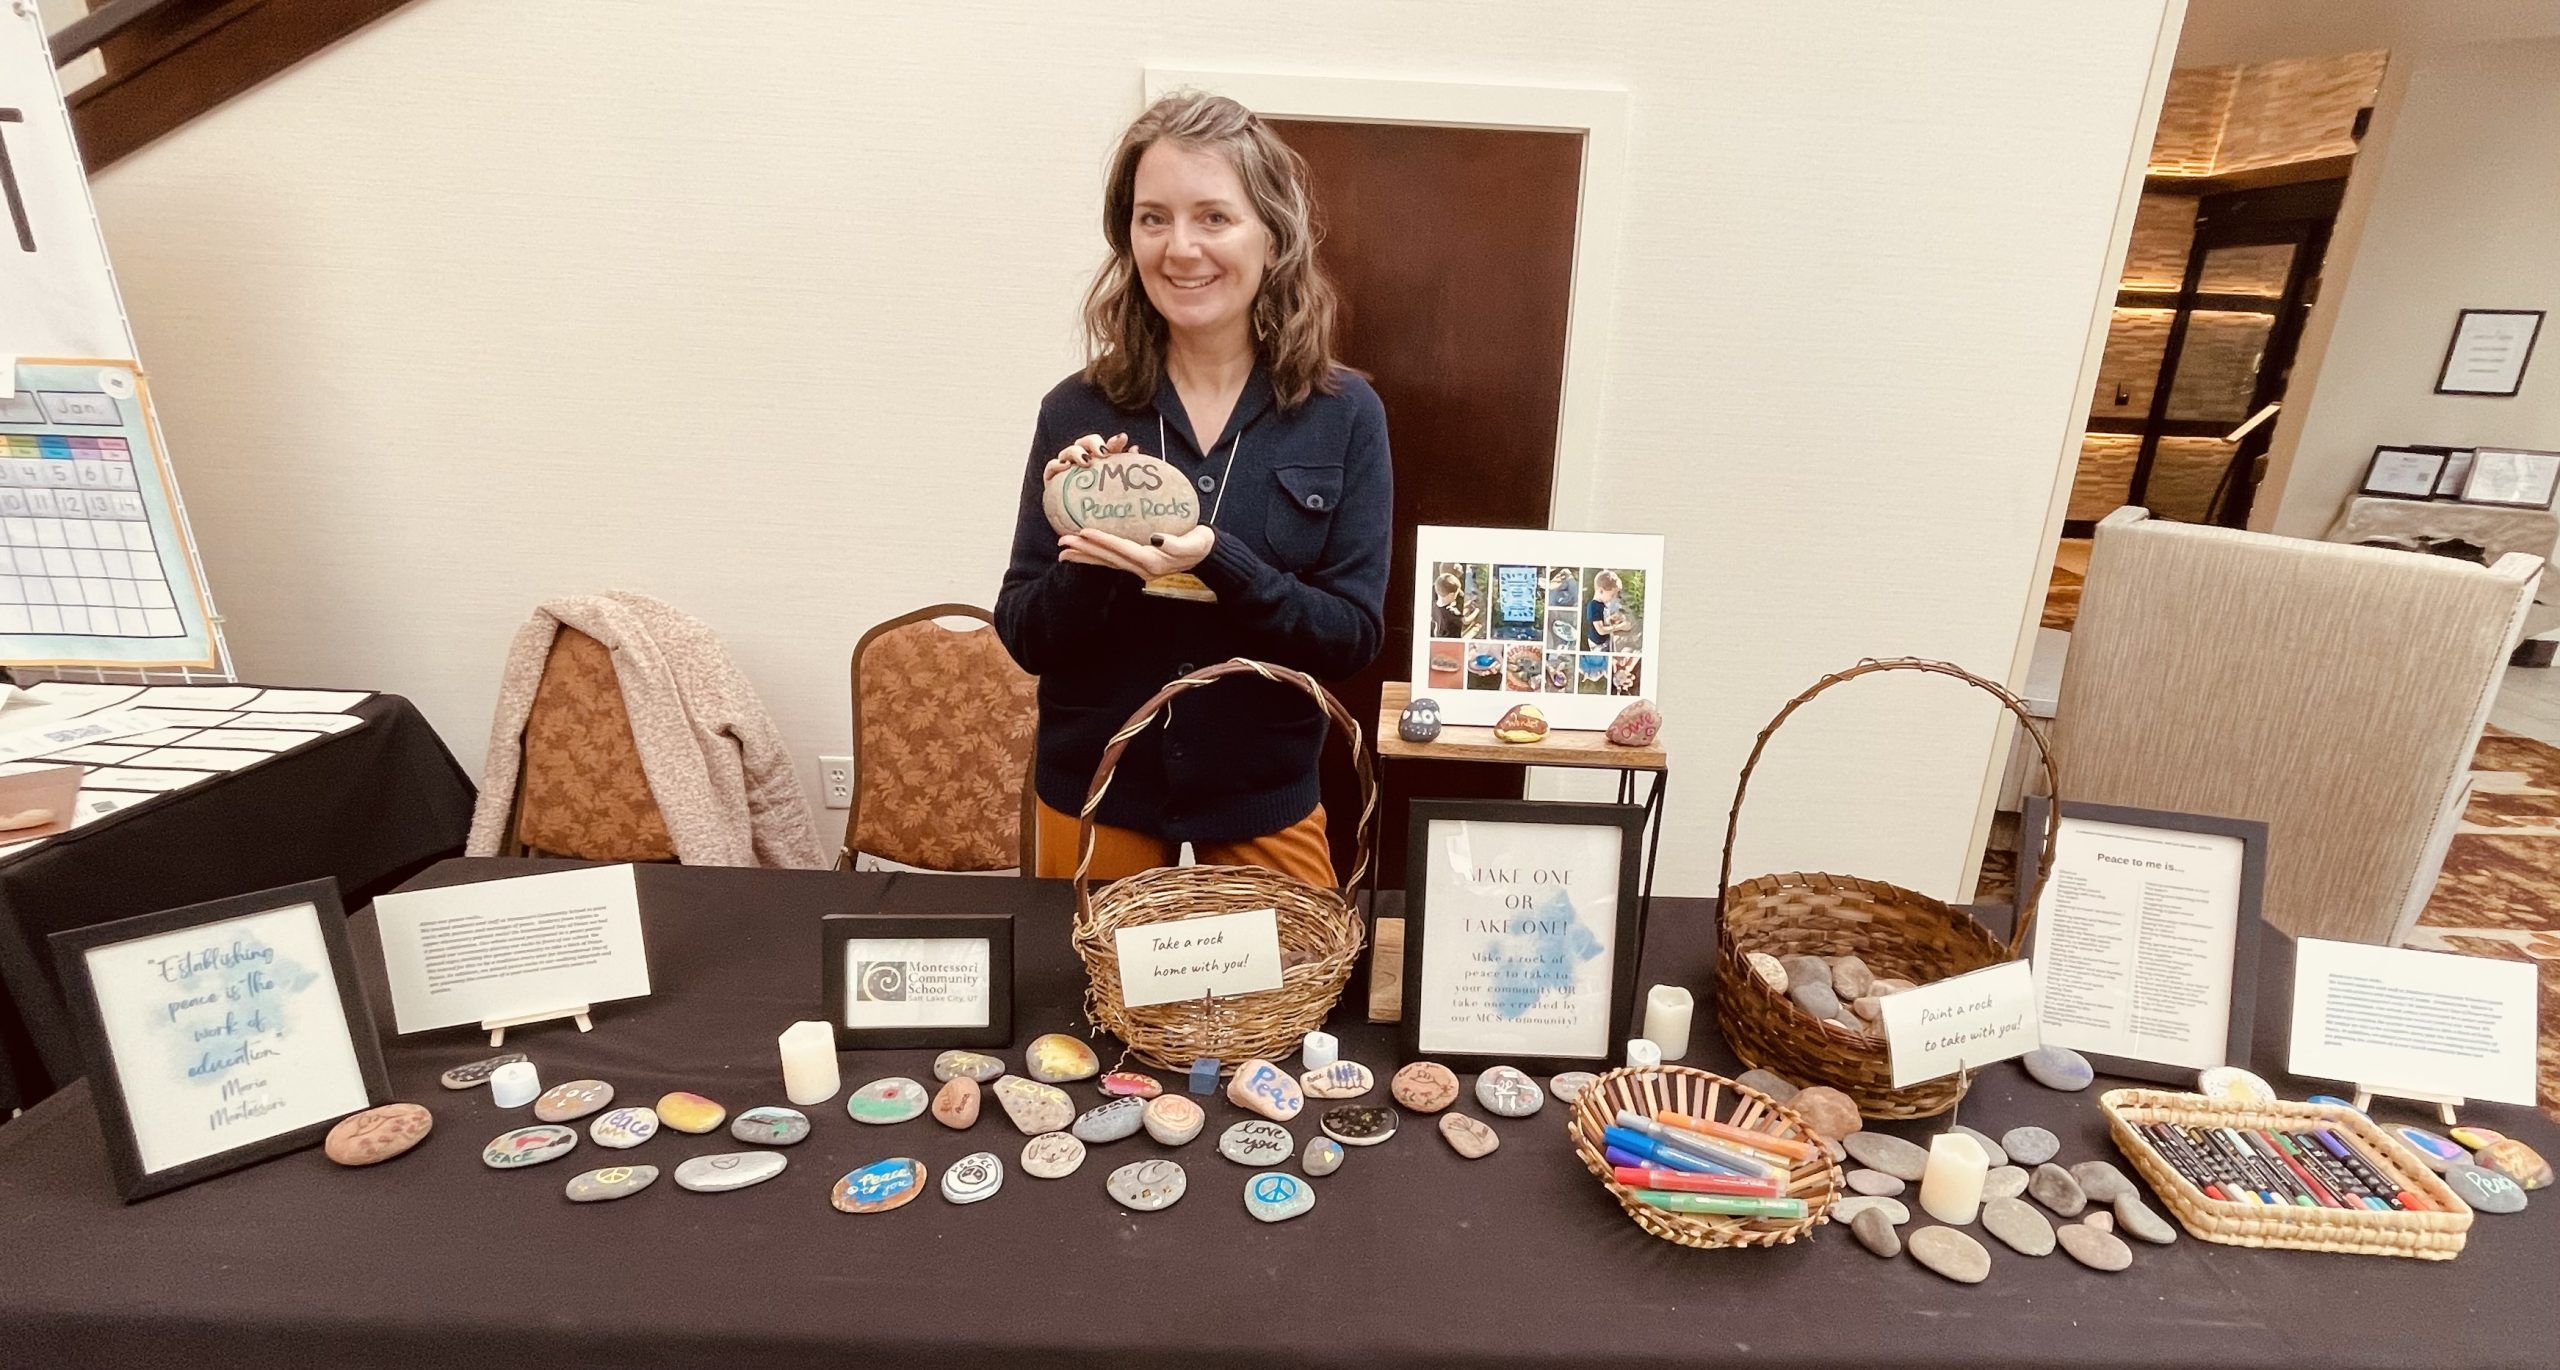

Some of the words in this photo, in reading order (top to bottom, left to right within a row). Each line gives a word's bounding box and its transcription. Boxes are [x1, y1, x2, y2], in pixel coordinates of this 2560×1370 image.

[22, 466, 37, 480] 4
[52, 466, 66, 481] 5
[85, 466, 96, 481] 6
[113, 467, 124, 481] 7
[1099, 463, 1163, 491] MCS
[34, 495, 48, 510] 11
[62, 497, 82, 512] 12
[90, 496, 108, 511] 13
[1081, 497, 1135, 520] Peace
[1139, 497, 1191, 520] Rocks
[2097, 853, 2129, 866] Peace
[2132, 857, 2143, 867] to
[2145, 860, 2162, 870] me
[1533, 869, 1574, 885] ONE
[1505, 895, 1533, 910] OR
[1464, 918, 1511, 934] TAKE
[1522, 919, 1568, 936] ONE!
[1152, 937, 1180, 951] Take
[1184, 939, 1191, 947] a
[1197, 931, 1224, 946] rock
[1154, 965, 1187, 977] home
[1192, 959, 1219, 973] with
[1222, 953, 1250, 973] you!
[1472, 952, 1501, 963] Make
[1518, 954, 1546, 964] rock
[1552, 955, 1564, 964] of
[909, 962, 978, 973] Montessori
[1464, 970, 1500, 980] peace
[1506, 970, 1518, 979] to
[1524, 970, 1551, 980] take
[1555, 971, 1568, 980] to
[908, 973, 978, 987] Community
[908, 984, 947, 994] School
[1455, 984, 1482, 994] your
[1487, 985, 1551, 996] community
[1453, 998, 1478, 1008] take
[1510, 1000, 1558, 1010] created
[1921, 1006, 1953, 1025] Paint
[1956, 1006, 1965, 1015] a
[1969, 994, 1993, 1011] rock
[194, 1012, 237, 1042] work
[247, 1009, 267, 1032] of
[1477, 1013, 1503, 1022] MCS
[1925, 1040, 1936, 1052] to
[1941, 1032, 1966, 1048] take
[1970, 1024, 1995, 1040] with
[1998, 1014, 2022, 1038] you!
[222, 1078, 268, 1101] Maria
[1251, 1065, 1299, 1111] Peace
[209, 1097, 286, 1130] Montessori
[1236, 1136, 1281, 1155] you
[486, 1150, 535, 1164] PEACE
[859, 1168, 910, 1187] Peace
